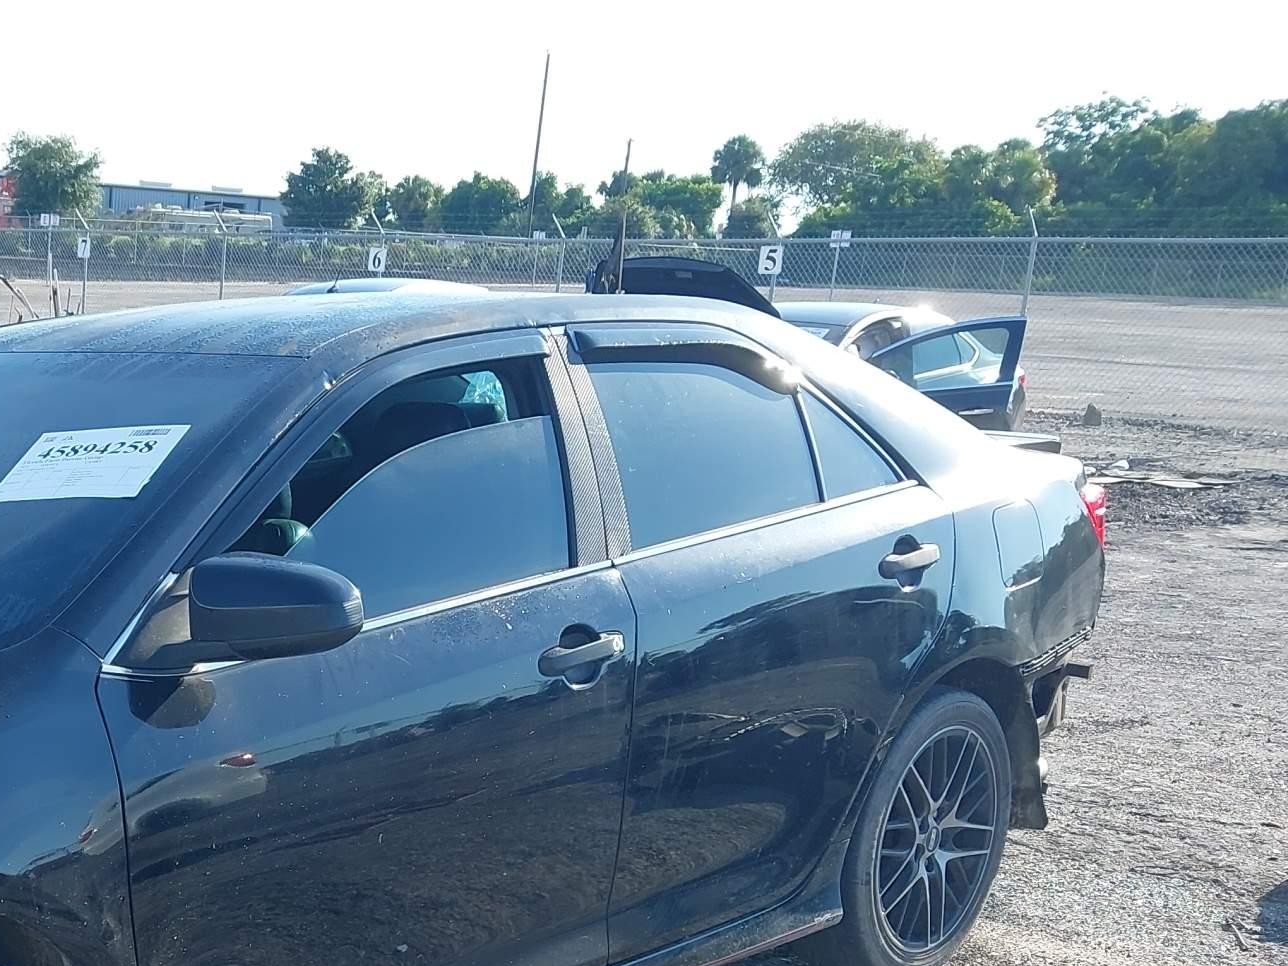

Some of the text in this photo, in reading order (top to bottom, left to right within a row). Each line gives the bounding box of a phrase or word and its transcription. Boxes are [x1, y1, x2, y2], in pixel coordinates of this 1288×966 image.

[80, 239, 88, 257] 7
[372, 249, 383, 270] 6
[764, 248, 778, 271] 5
[38, 440, 158, 459] 45894258
